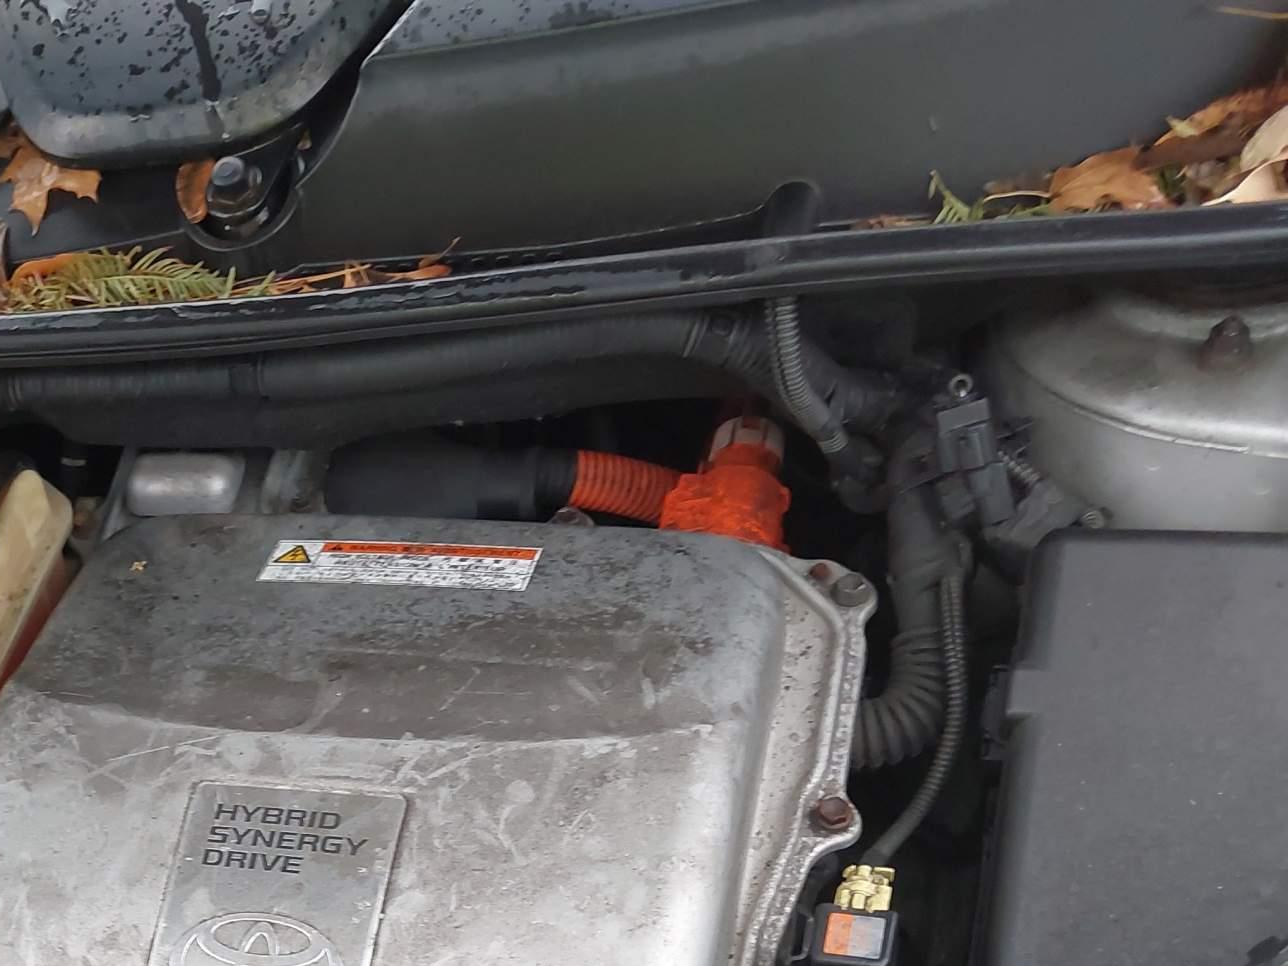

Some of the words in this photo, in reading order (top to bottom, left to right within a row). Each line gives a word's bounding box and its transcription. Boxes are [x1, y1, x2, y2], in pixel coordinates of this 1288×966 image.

[213, 803, 342, 830] HYBRID
[206, 825, 369, 856] SYNERGY
[201, 848, 305, 874] DRIVE
